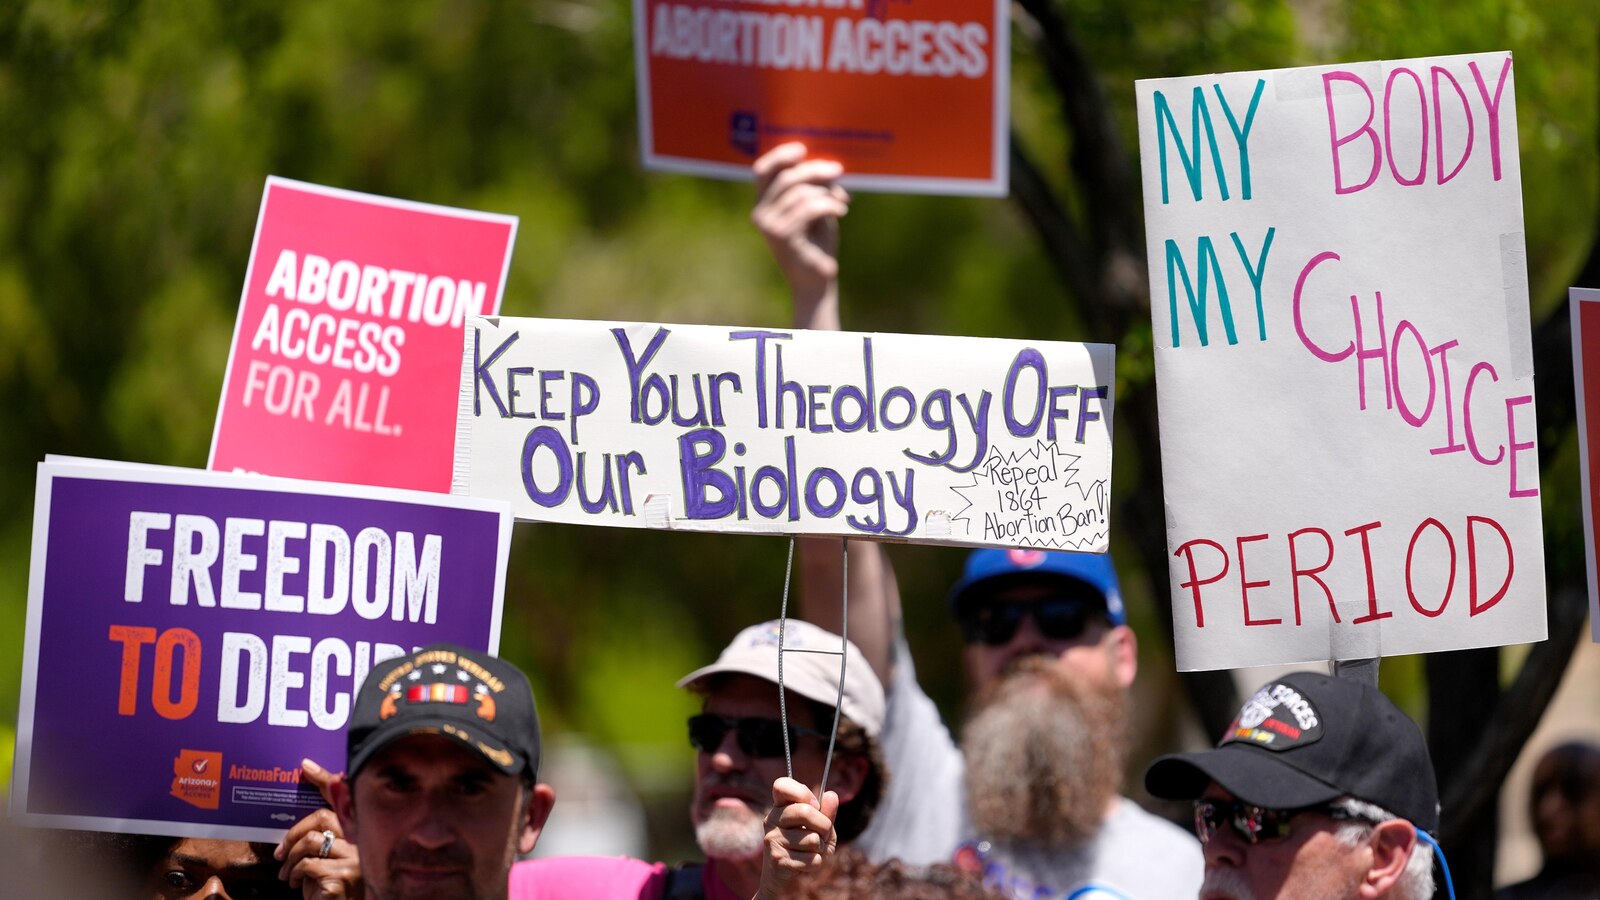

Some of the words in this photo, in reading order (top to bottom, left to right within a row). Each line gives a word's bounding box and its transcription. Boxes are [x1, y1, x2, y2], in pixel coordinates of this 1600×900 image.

[651, 4, 824, 70] ABORTION
[827, 17, 988, 78] ACCESS
[1153, 78, 1266, 205] MY
[1321, 57, 1513, 195] BODY
[265, 249, 487, 329] ABORTION
[251, 303, 405, 377] ACCESS
[1165, 227, 1276, 348] MY
[1292, 250, 1539, 499] CHOICE
[242, 359, 320, 422] FOR
[325, 379, 402, 437] ALL.
[520, 425, 647, 516] Our
[676, 428, 918, 536] Biology
[983, 447, 1058, 495] Repeal
[998, 486, 1047, 513] 1864
[984, 510, 1056, 540] Abortion
[1056, 484, 1105, 536] Ban!
[124, 511, 443, 625] FREEDOM
[1173, 516, 1515, 628] PERIOD
[108, 624, 202, 721] TO
[217, 631, 424, 731] DECI
[178, 777, 212, 786] Arizona
